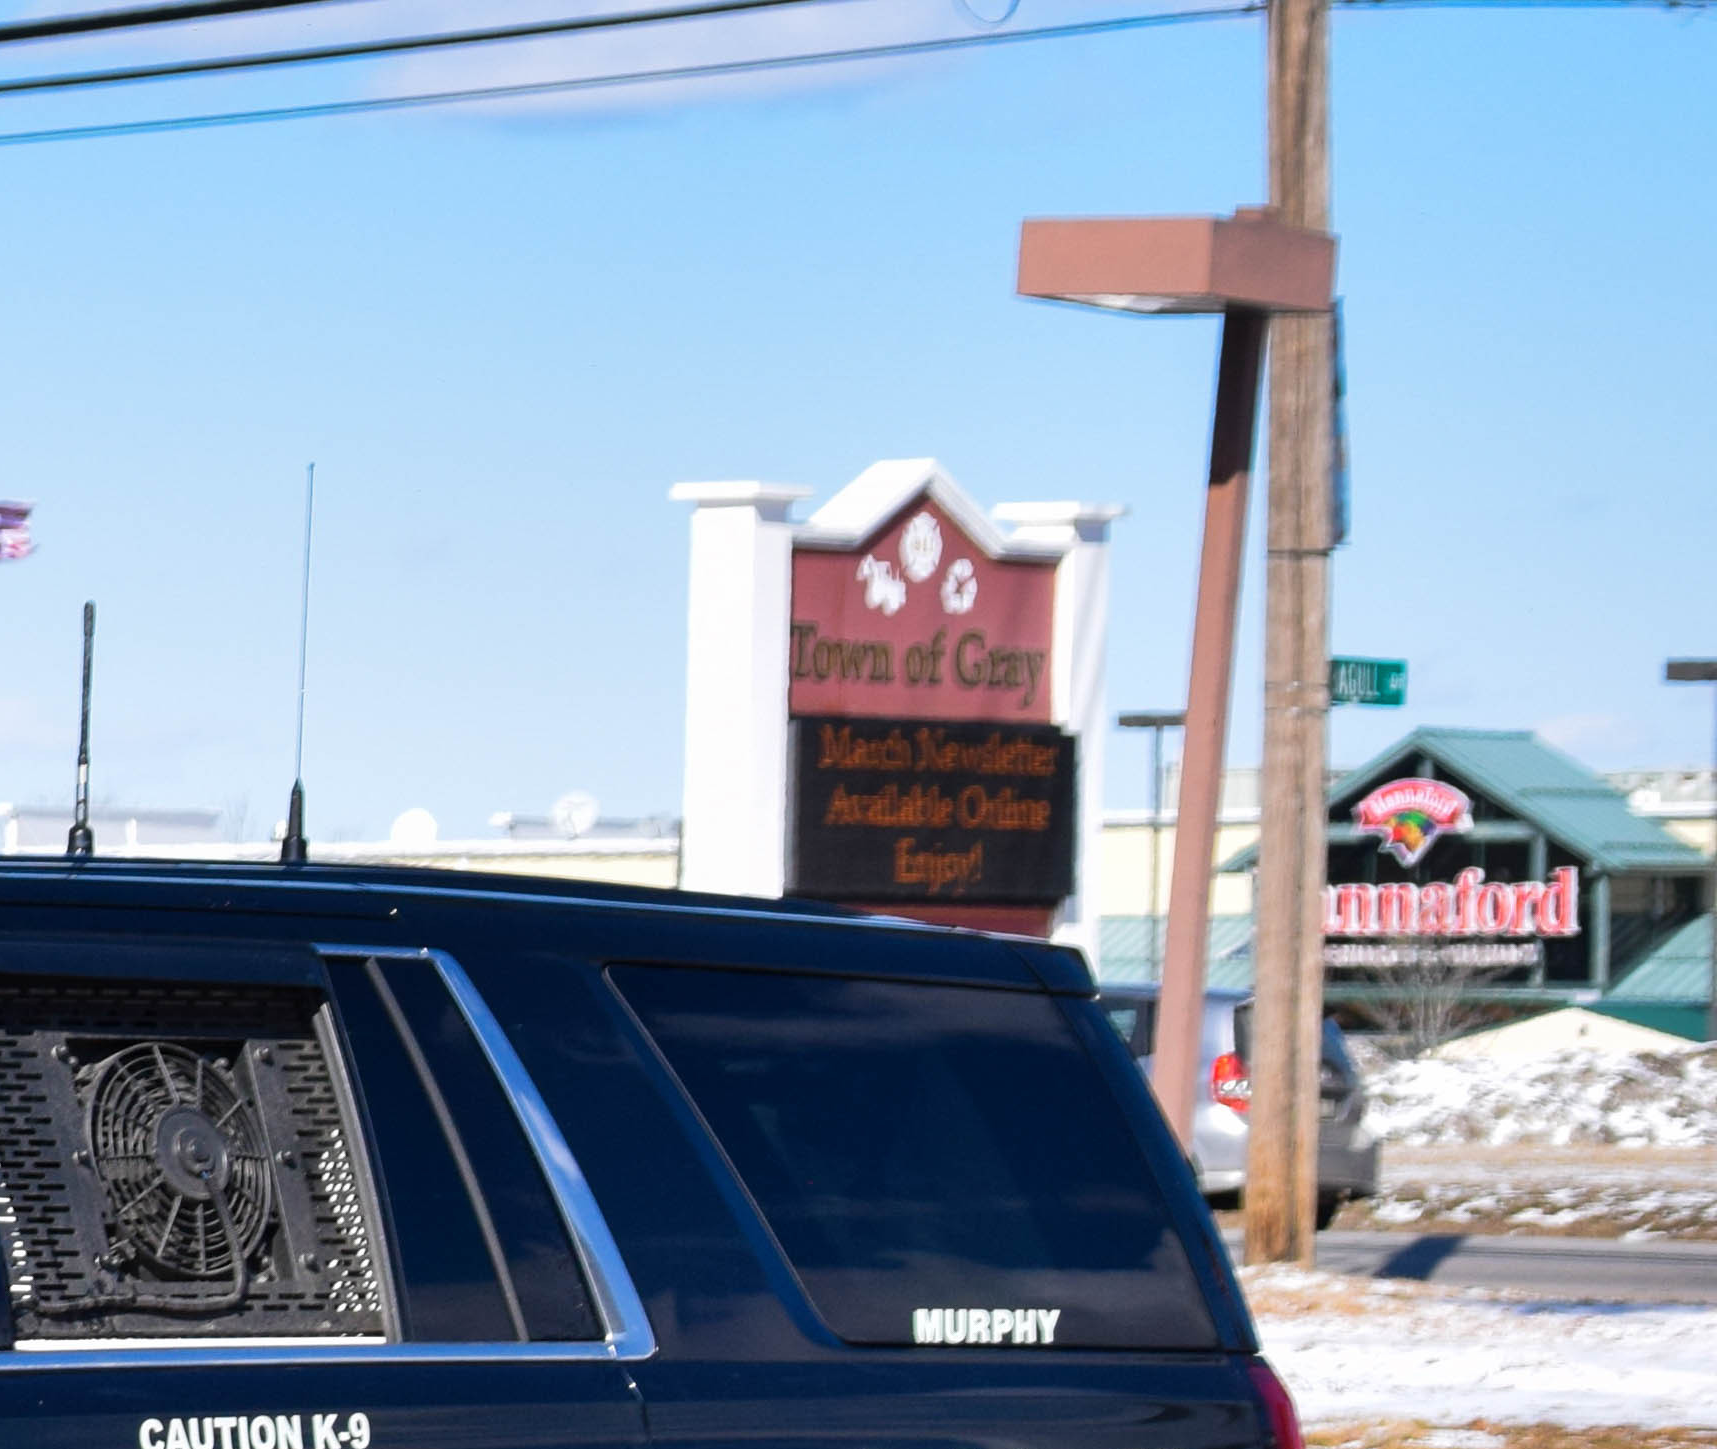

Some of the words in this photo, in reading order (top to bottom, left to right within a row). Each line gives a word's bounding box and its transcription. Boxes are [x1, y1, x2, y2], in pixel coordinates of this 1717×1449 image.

[791, 621, 895, 684] Town
[905, 623, 949, 685] of
[956, 629, 1045, 708] Gray
[818, 723, 912, 771] March
[915, 727, 1057, 776] Newsletter
[823, 784, 954, 828] Available
[957, 784, 1052, 831] Online
[893, 836, 983, 896] Enjoy!
[913, 1308, 1061, 1344] MURPHY
